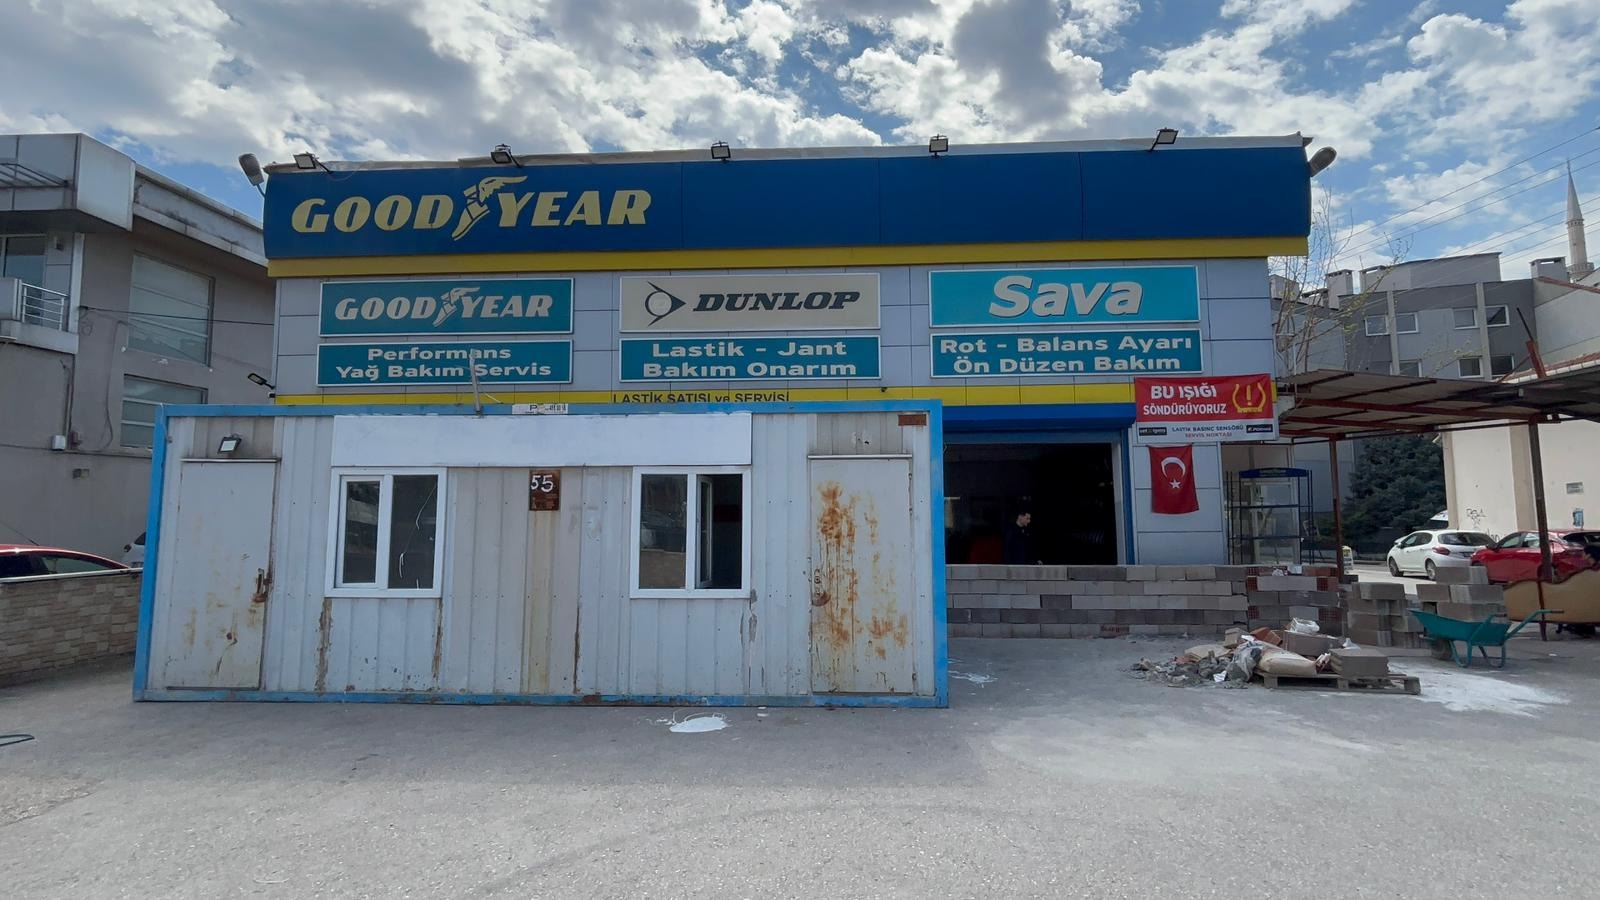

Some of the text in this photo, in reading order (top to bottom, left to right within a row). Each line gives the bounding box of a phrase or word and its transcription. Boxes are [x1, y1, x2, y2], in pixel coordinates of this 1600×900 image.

[693, 291, 861, 312] DUNLOP
[988, 275, 1143, 318] Sava
[368, 345, 512, 361] Performans
[652, 341, 745, 358] Lastik
[777, 340, 847, 358] Jant
[940, 338, 987, 354] Rot
[1017, 337, 1109, 352] Balans
[1117, 335, 1192, 353] Ayarı
[335, 362, 552, 381] Yağ Bakım Servis
[643, 361, 857, 378] Bakım Onarım
[953, 355, 1180, 374] Ön Düzen Bakım
[1151, 382, 1217, 400] BU IŞIĞI
[1143, 402, 1227, 416] SÖNDÜRÜYORUZ
[530, 474, 554, 493] 55
